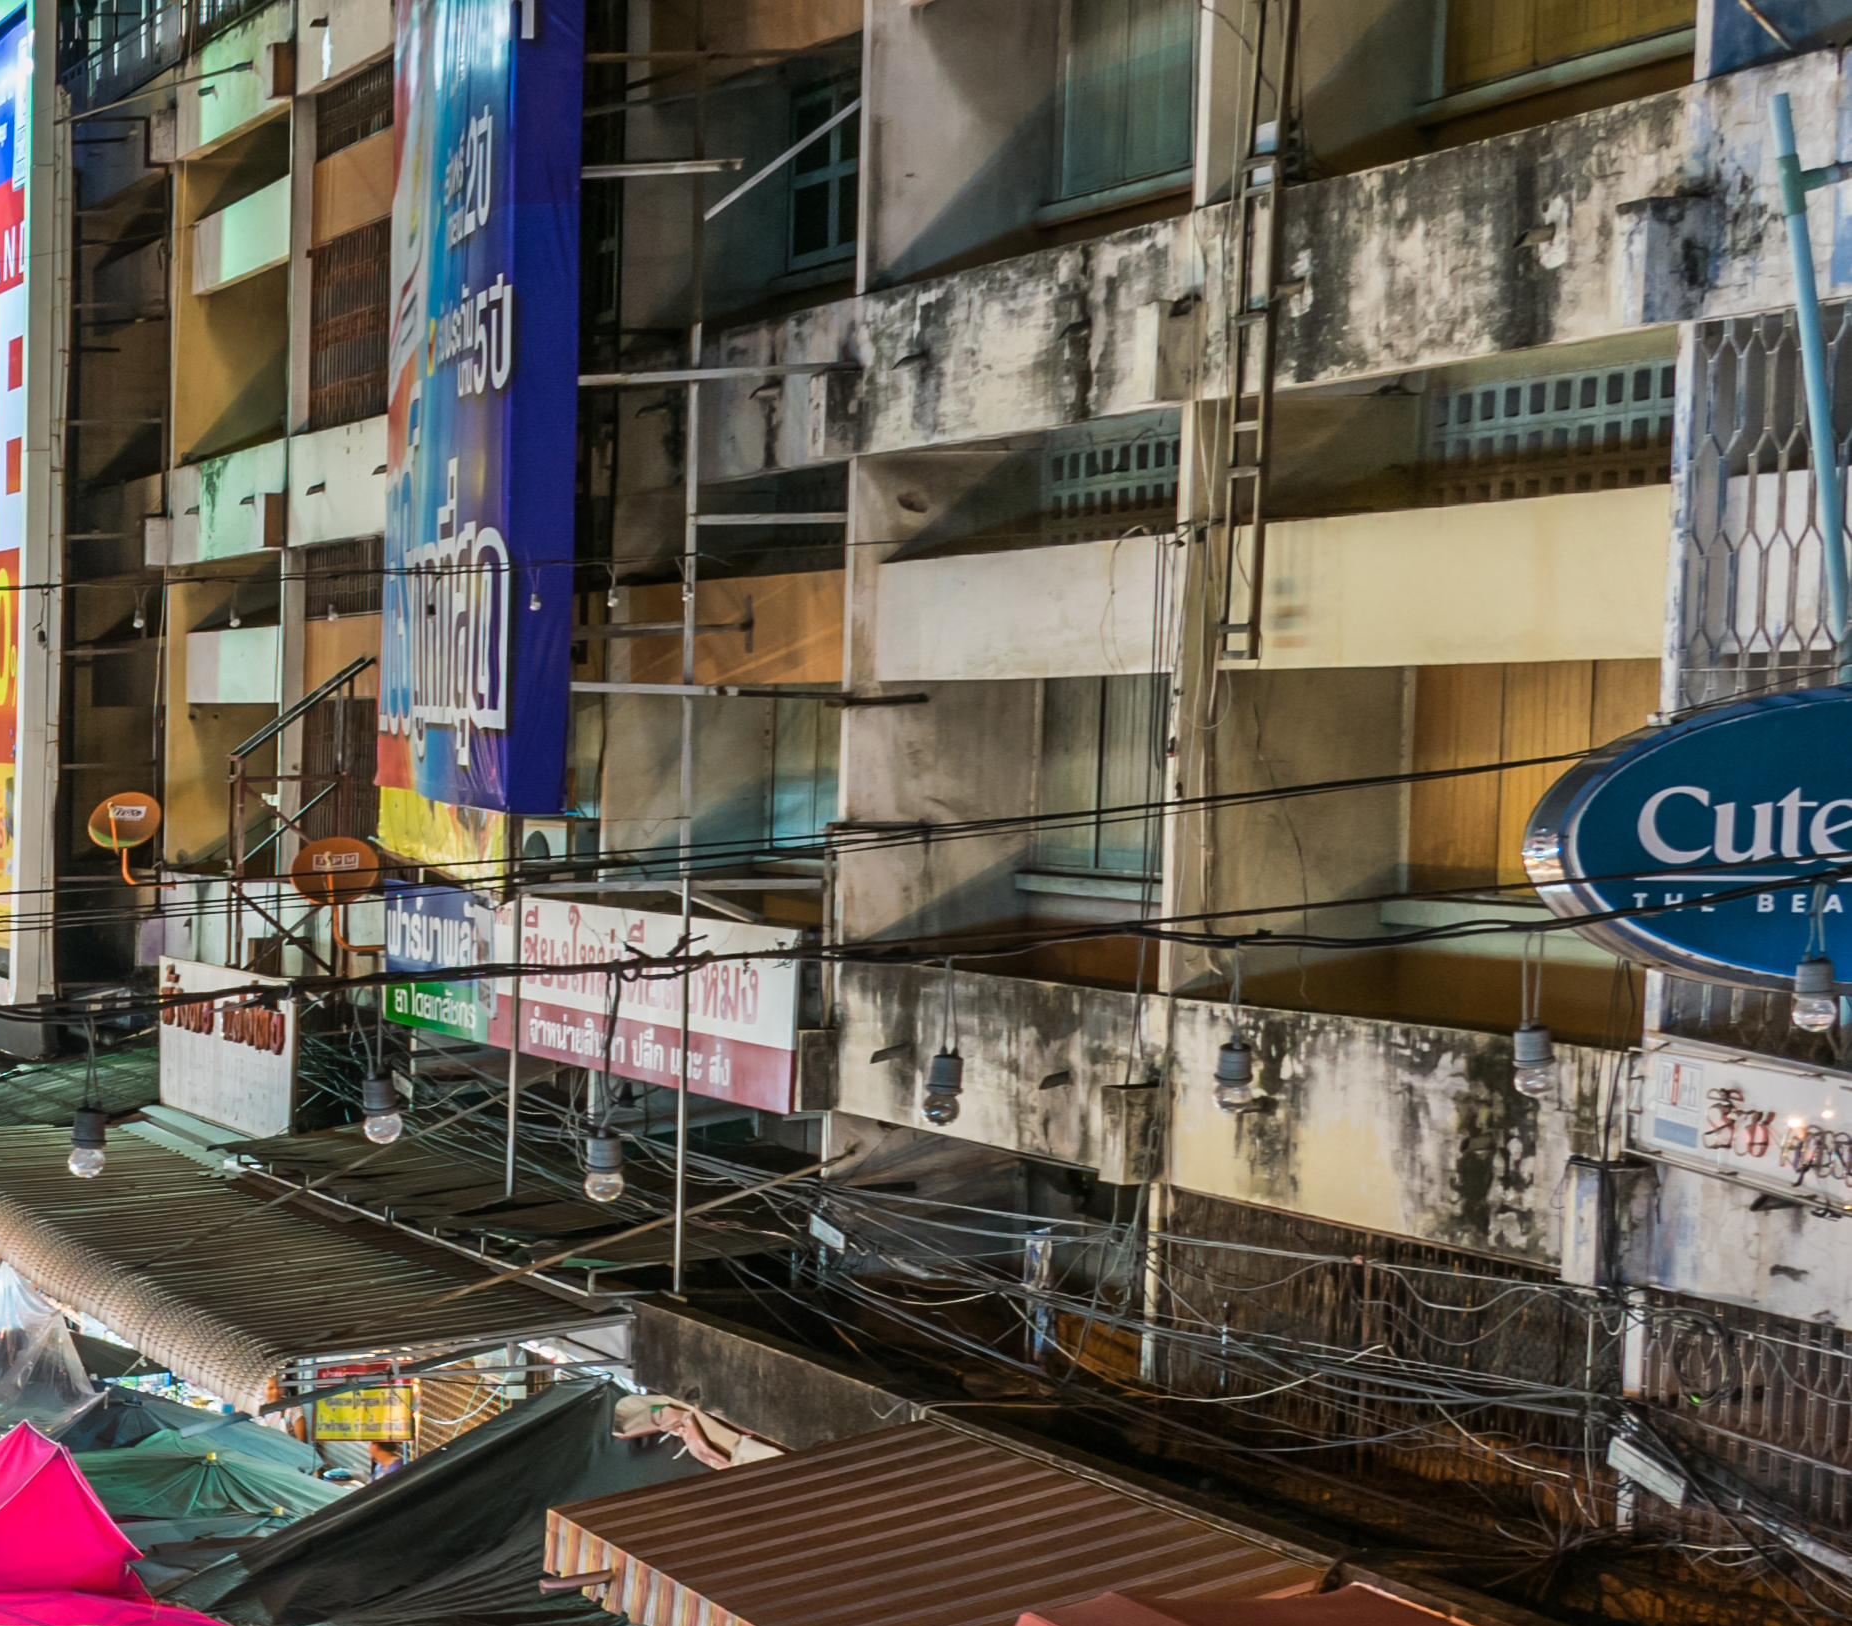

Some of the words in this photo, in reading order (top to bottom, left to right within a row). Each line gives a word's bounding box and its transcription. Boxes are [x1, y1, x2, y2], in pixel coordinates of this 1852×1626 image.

[1636, 785, 1852, 865] Cute
[1632, 893, 1716, 914] THE
[527, 1005, 626, 1065] จำหน่ายสินา
[670, 1048, 703, 1081] แะ
